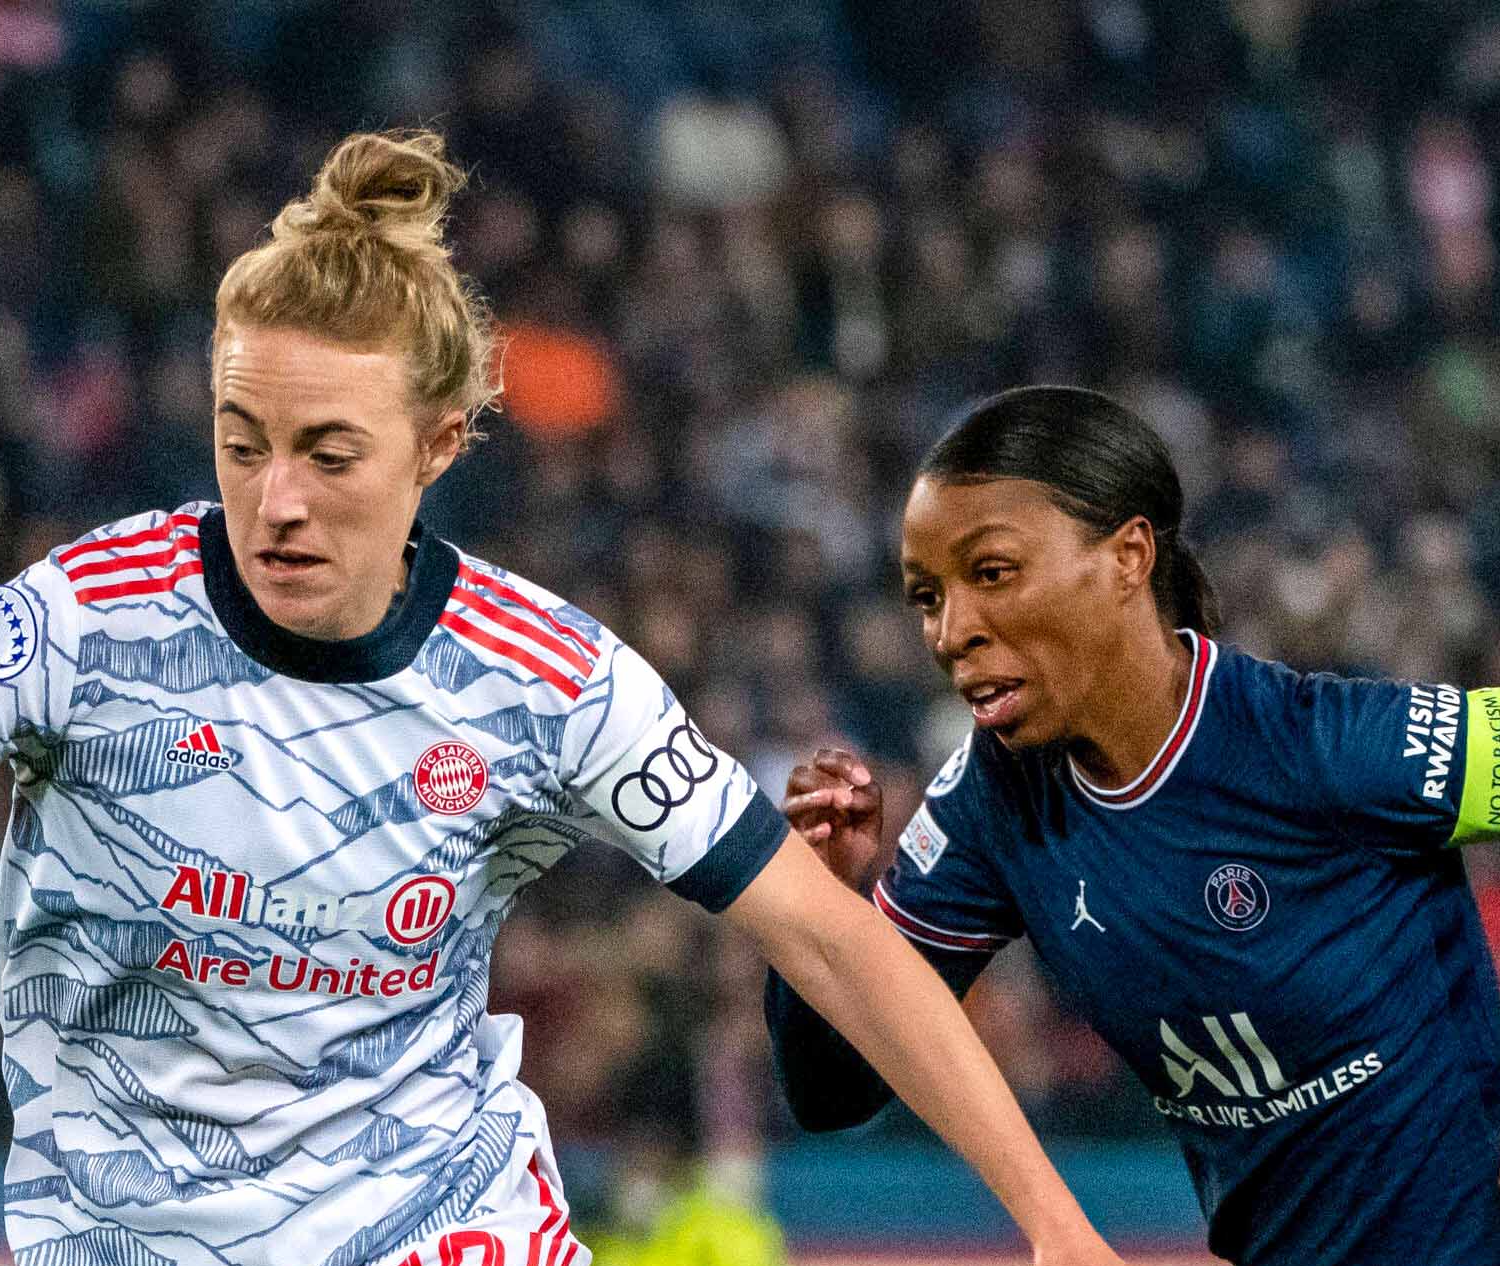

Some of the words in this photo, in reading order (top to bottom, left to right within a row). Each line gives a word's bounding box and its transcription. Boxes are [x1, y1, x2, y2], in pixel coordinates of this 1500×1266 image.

[1404, 686, 1435, 758] VISIT
[166, 748, 230, 769] adidas
[421, 754, 436, 771] FC
[438, 746, 482, 775] BAYERN
[1211, 868, 1250, 888] PARIS
[154, 940, 250, 985] Are
[268, 951, 439, 997] United
[1207, 1105, 1254, 1128] LIVE
[1252, 1052, 1383, 1124] LIMITLESS
